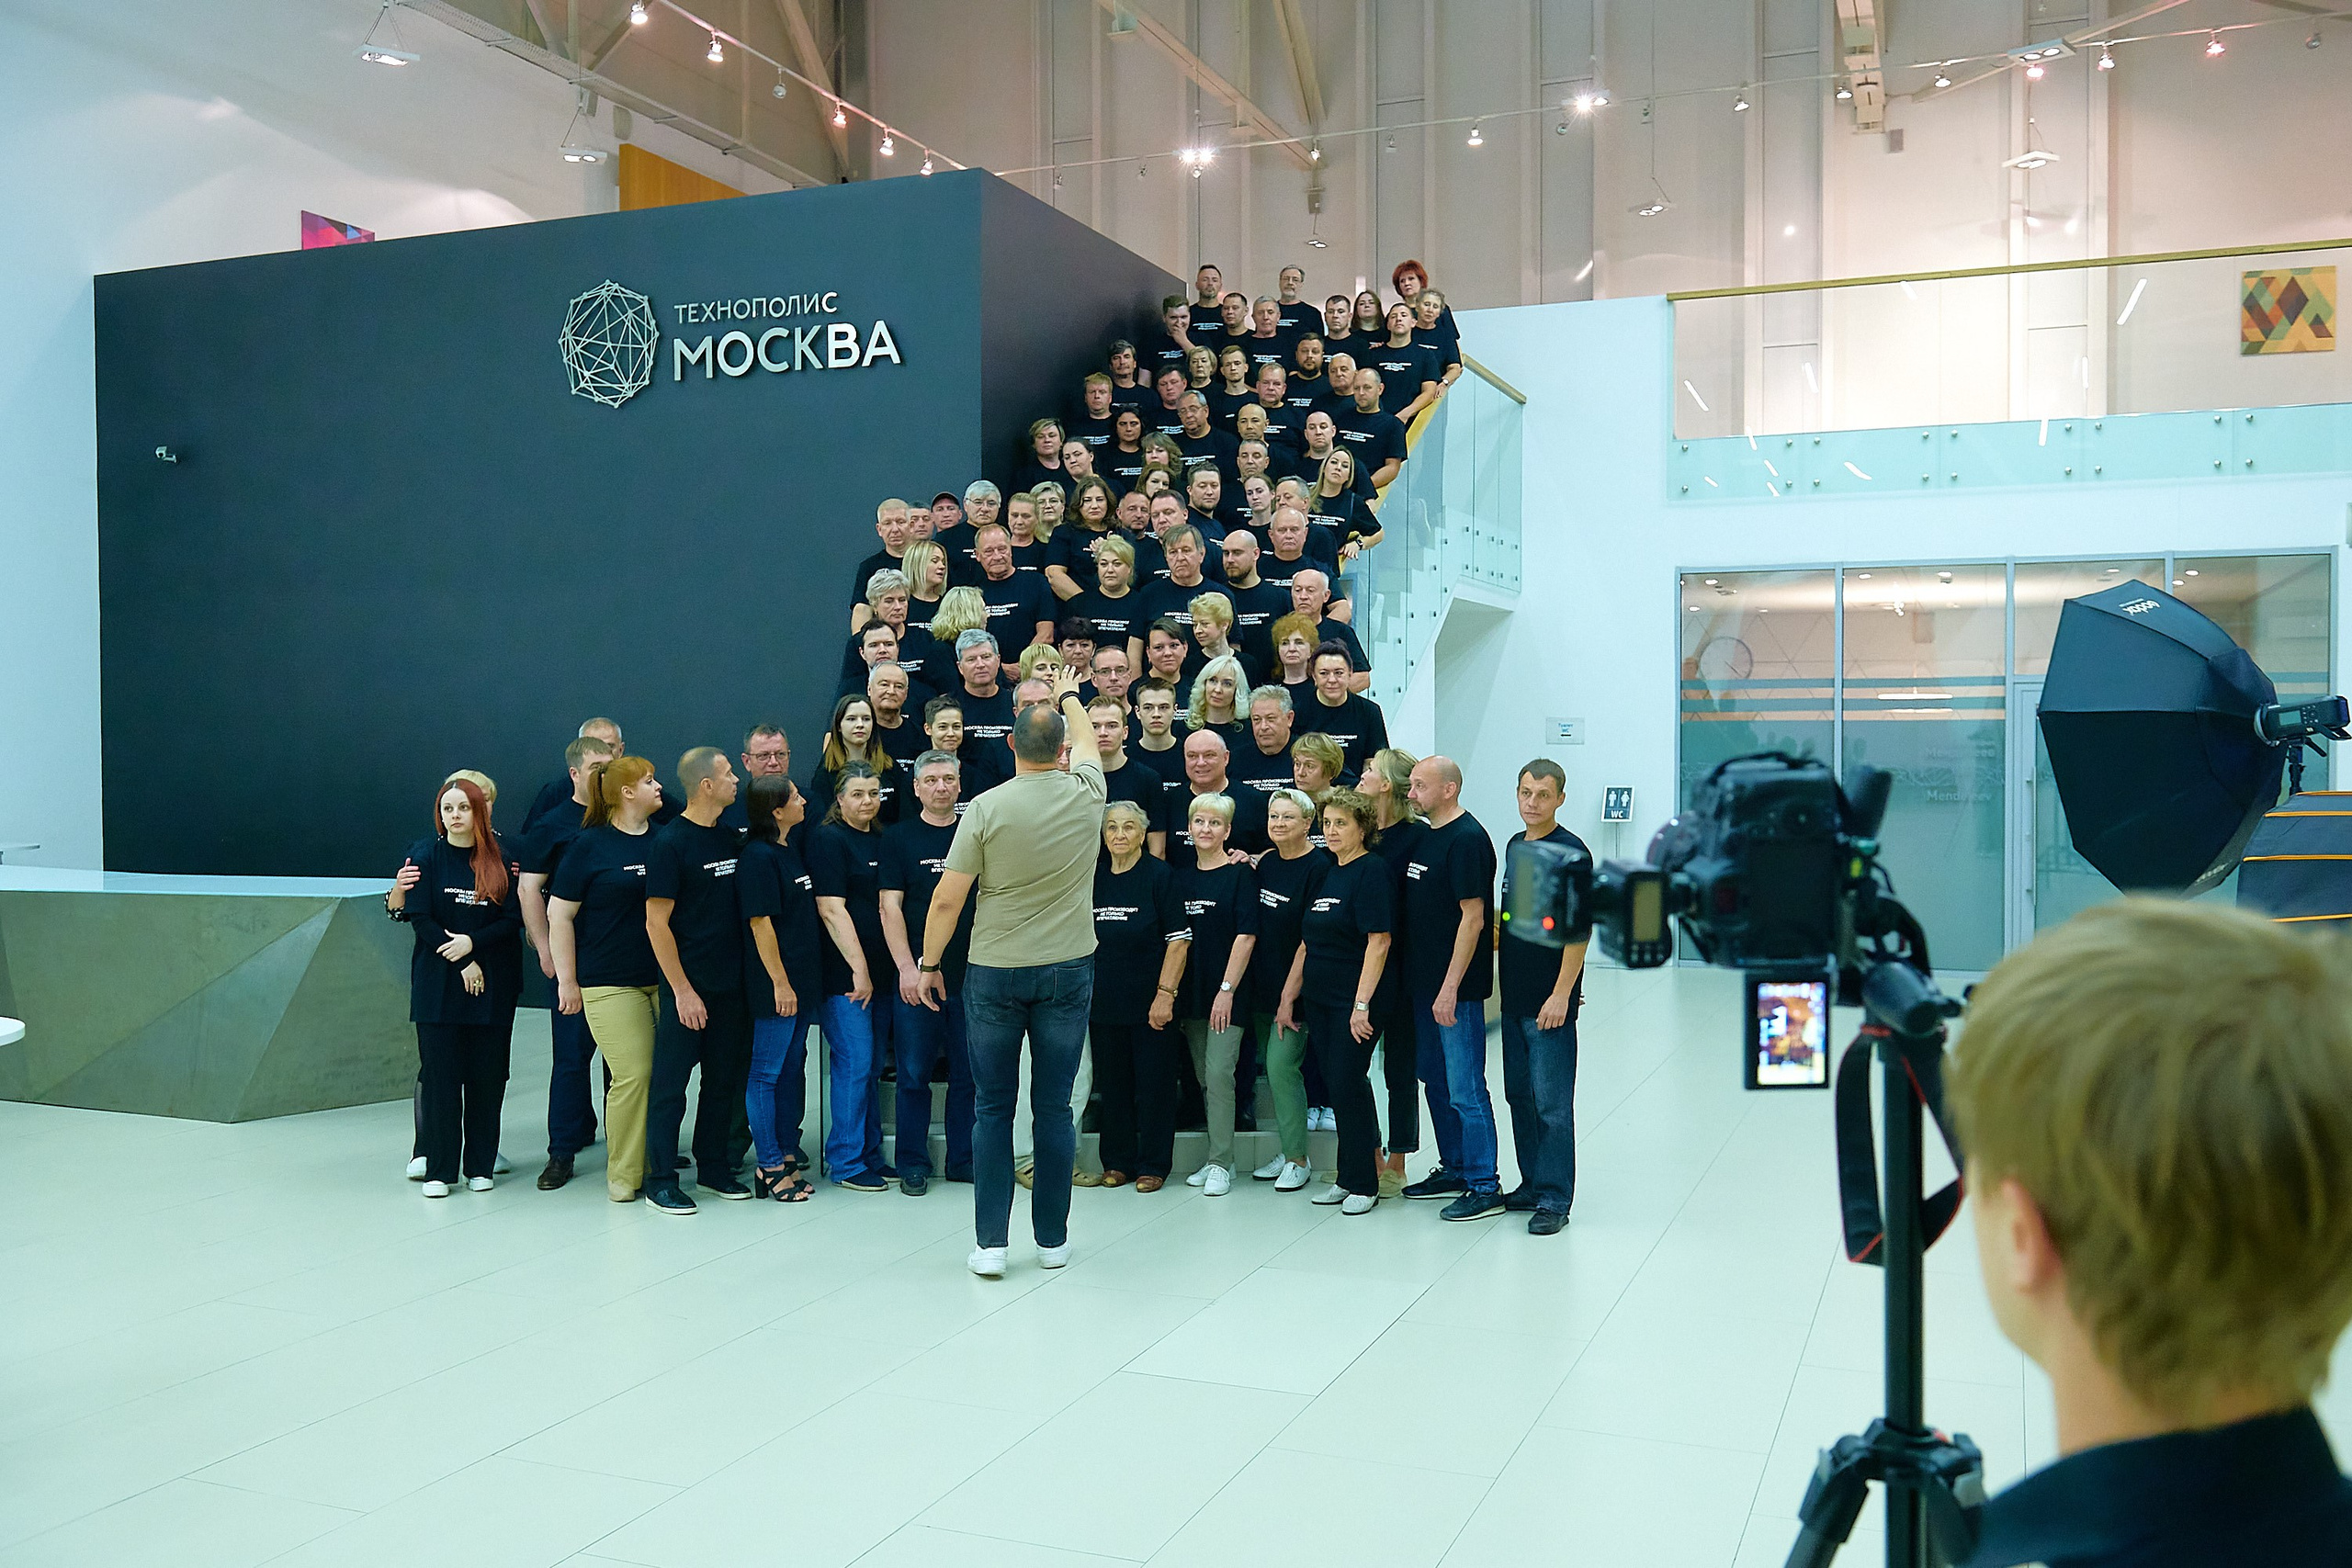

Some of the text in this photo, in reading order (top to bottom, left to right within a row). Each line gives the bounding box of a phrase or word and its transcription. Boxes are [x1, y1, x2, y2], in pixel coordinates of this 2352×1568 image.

[673, 291, 838, 324] ТЕХНОПОЛИС
[673, 320, 901, 381] МОСКВА
[1611, 810, 1623, 818] WC
